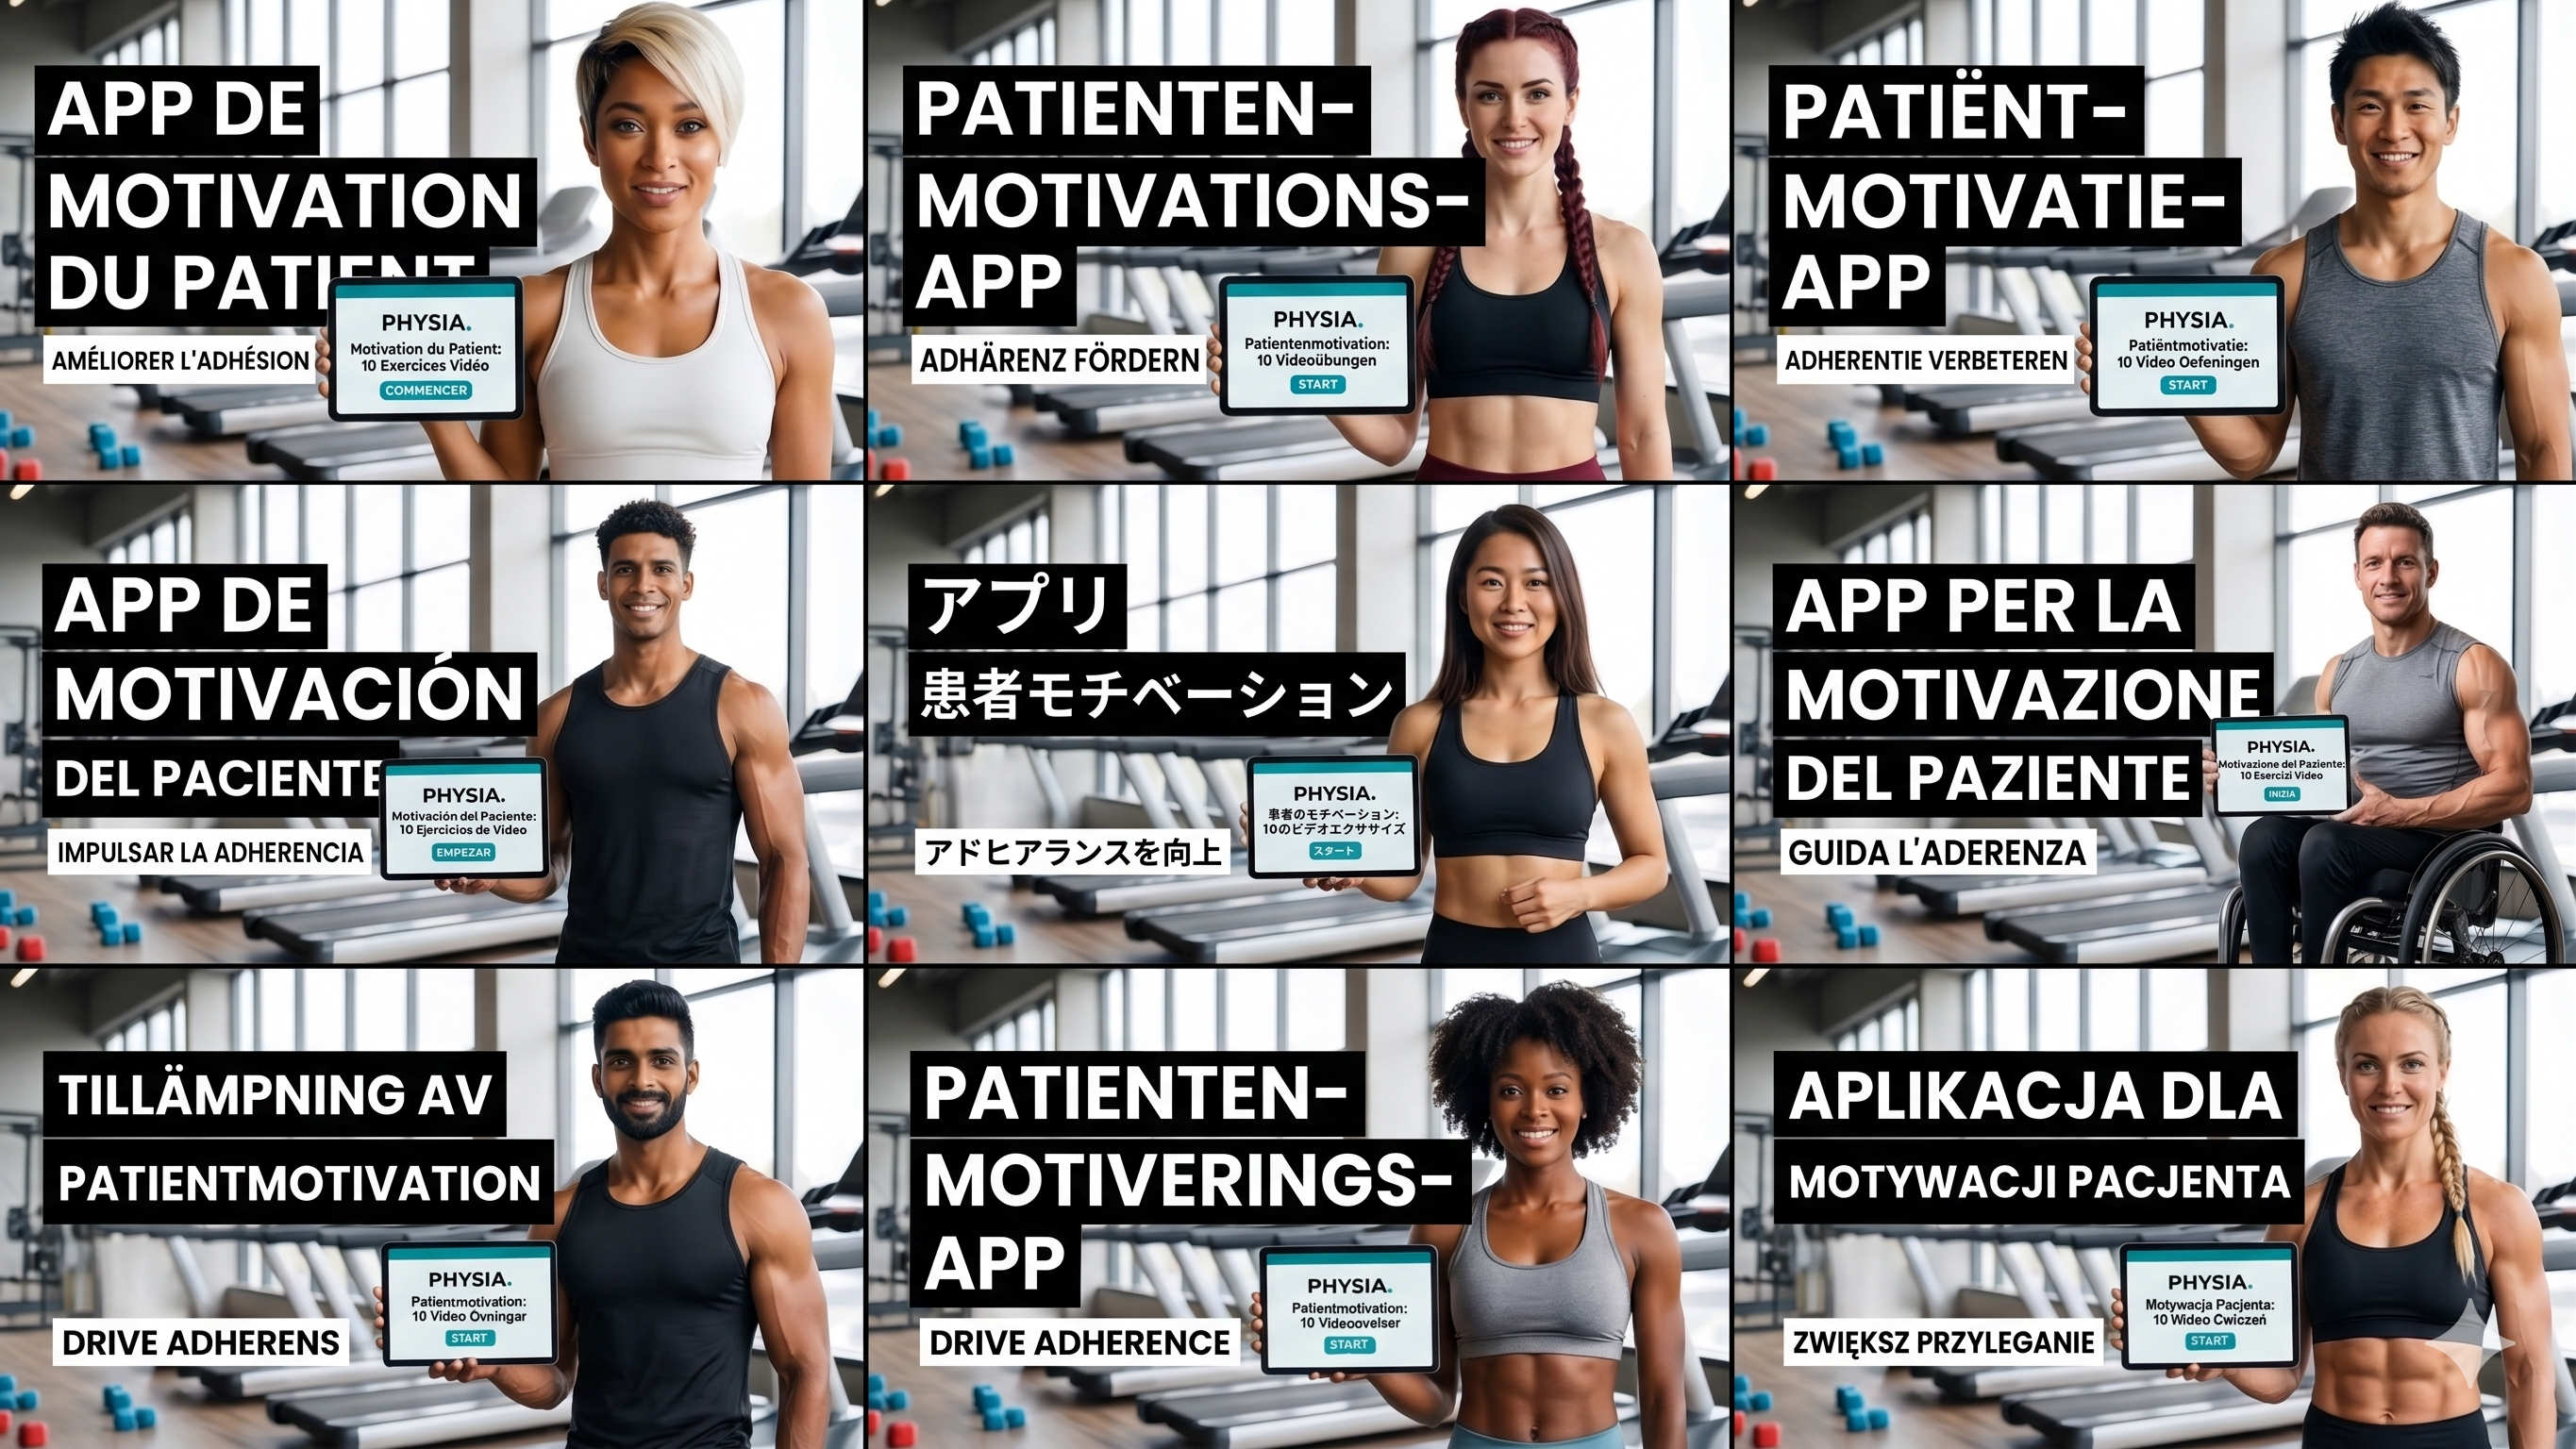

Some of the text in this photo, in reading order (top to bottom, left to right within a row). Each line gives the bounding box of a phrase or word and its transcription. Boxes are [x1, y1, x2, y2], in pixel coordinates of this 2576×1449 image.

[382, 313, 472, 332] PHYSIA.
[1274, 310, 1363, 328] PHYSIA.
[2145, 310, 2234, 329] PHYSIA.
[350, 341, 502, 356] Motivation du Patient:
[1245, 336, 1390, 350] Patientenmotivation:
[2129, 338, 2249, 352] Patiëntmotivatie:
[361, 358, 490, 372] 10 Exercices Vidéo
[1257, 352, 1377, 370] 10 Videoübungen
[2116, 354, 2260, 372] 10 Video Oefeningen
[385, 385, 468, 396] COMMENCER
[1298, 378, 1339, 390] START
[2168, 379, 2208, 391] START
[2247, 740, 2316, 754] PHYSIA.
[2218, 758, 2346, 769] Motivazione del Paziente:
[2240, 770, 2324, 780] 10 Esercizi Video
[423, 787, 506, 804] PHYSIA.
[1294, 785, 1377, 802] PHYSIA.
[2268, 790, 2296, 798] INIZIA
[392, 810, 537, 822] Motivación del Paciente:
[399, 824, 527, 838] 10 Ejercicios de Video
[436, 847, 492, 858] EMPEZAR
[428, 1271, 512, 1288] PHYSIA.
[1308, 1277, 1393, 1294] PHYSIA.
[2168, 1274, 2253, 1291] PHYSIA.
[411, 1295, 527, 1308] Patientmotivation:
[1292, 1302, 1408, 1314] Patientmotivation:
[2146, 1298, 2275, 1313] Motywacja Pacjenta:
[411, 1310, 427, 1322] 10
[429, 1309, 467, 1323] Video
[1300, 1316, 1401, 1329] 10 Videoovelser
[2152, 1313, 2168, 1325] 10
[2170, 1313, 2211, 1325] Wideo
[451, 1333, 488, 1343] START
[1330, 1339, 1369, 1350] START
[2191, 1335, 2229, 1346] START
